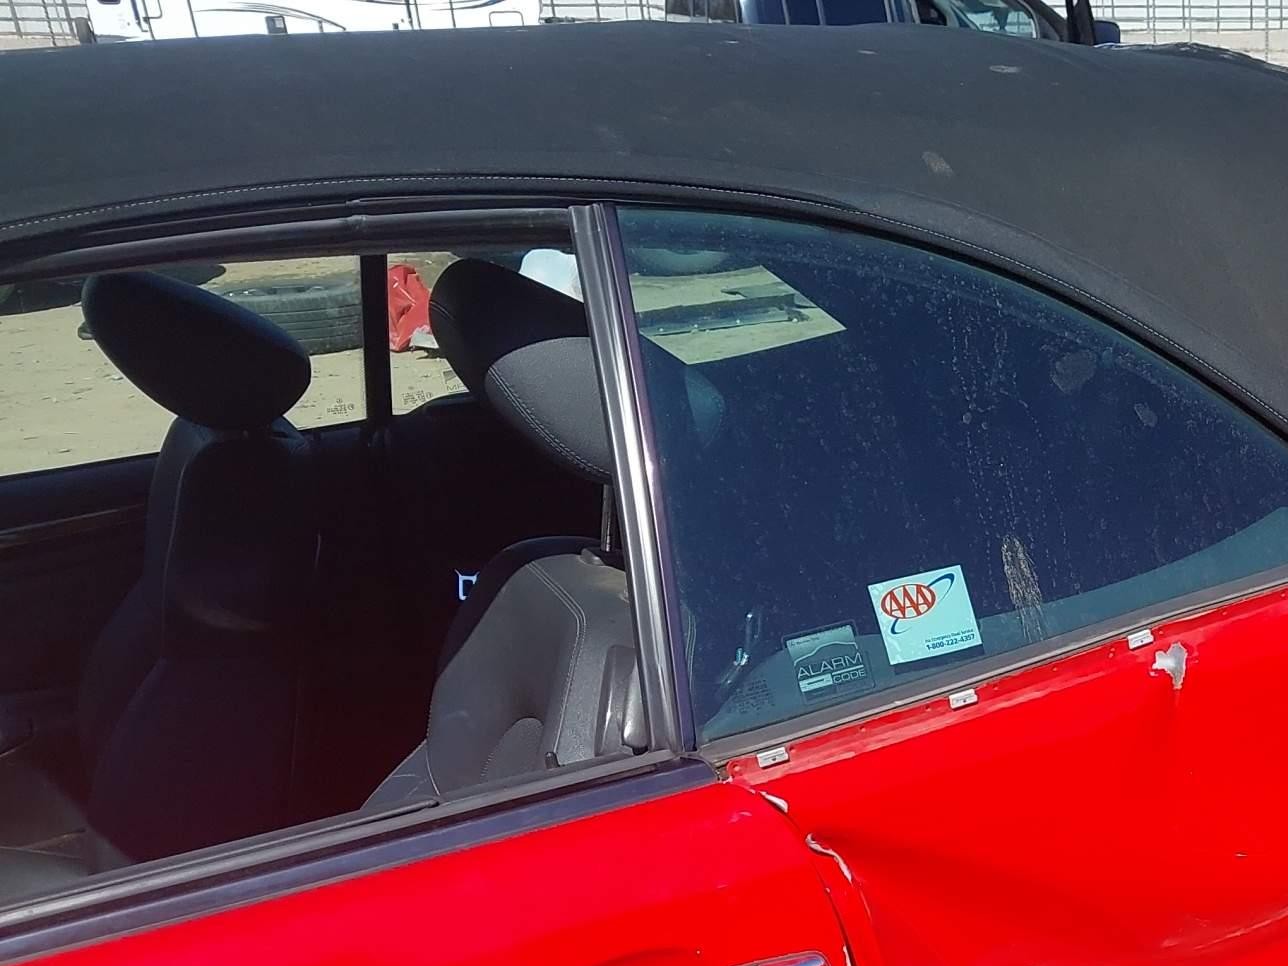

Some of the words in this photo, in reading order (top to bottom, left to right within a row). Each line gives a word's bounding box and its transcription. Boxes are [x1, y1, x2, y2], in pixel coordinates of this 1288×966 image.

[888, 583, 931, 619] AAA
[926, 633, 975, 651] 1-800-222-4357
[797, 652, 863, 679] ALARM
[831, 669, 867, 685] CODE
